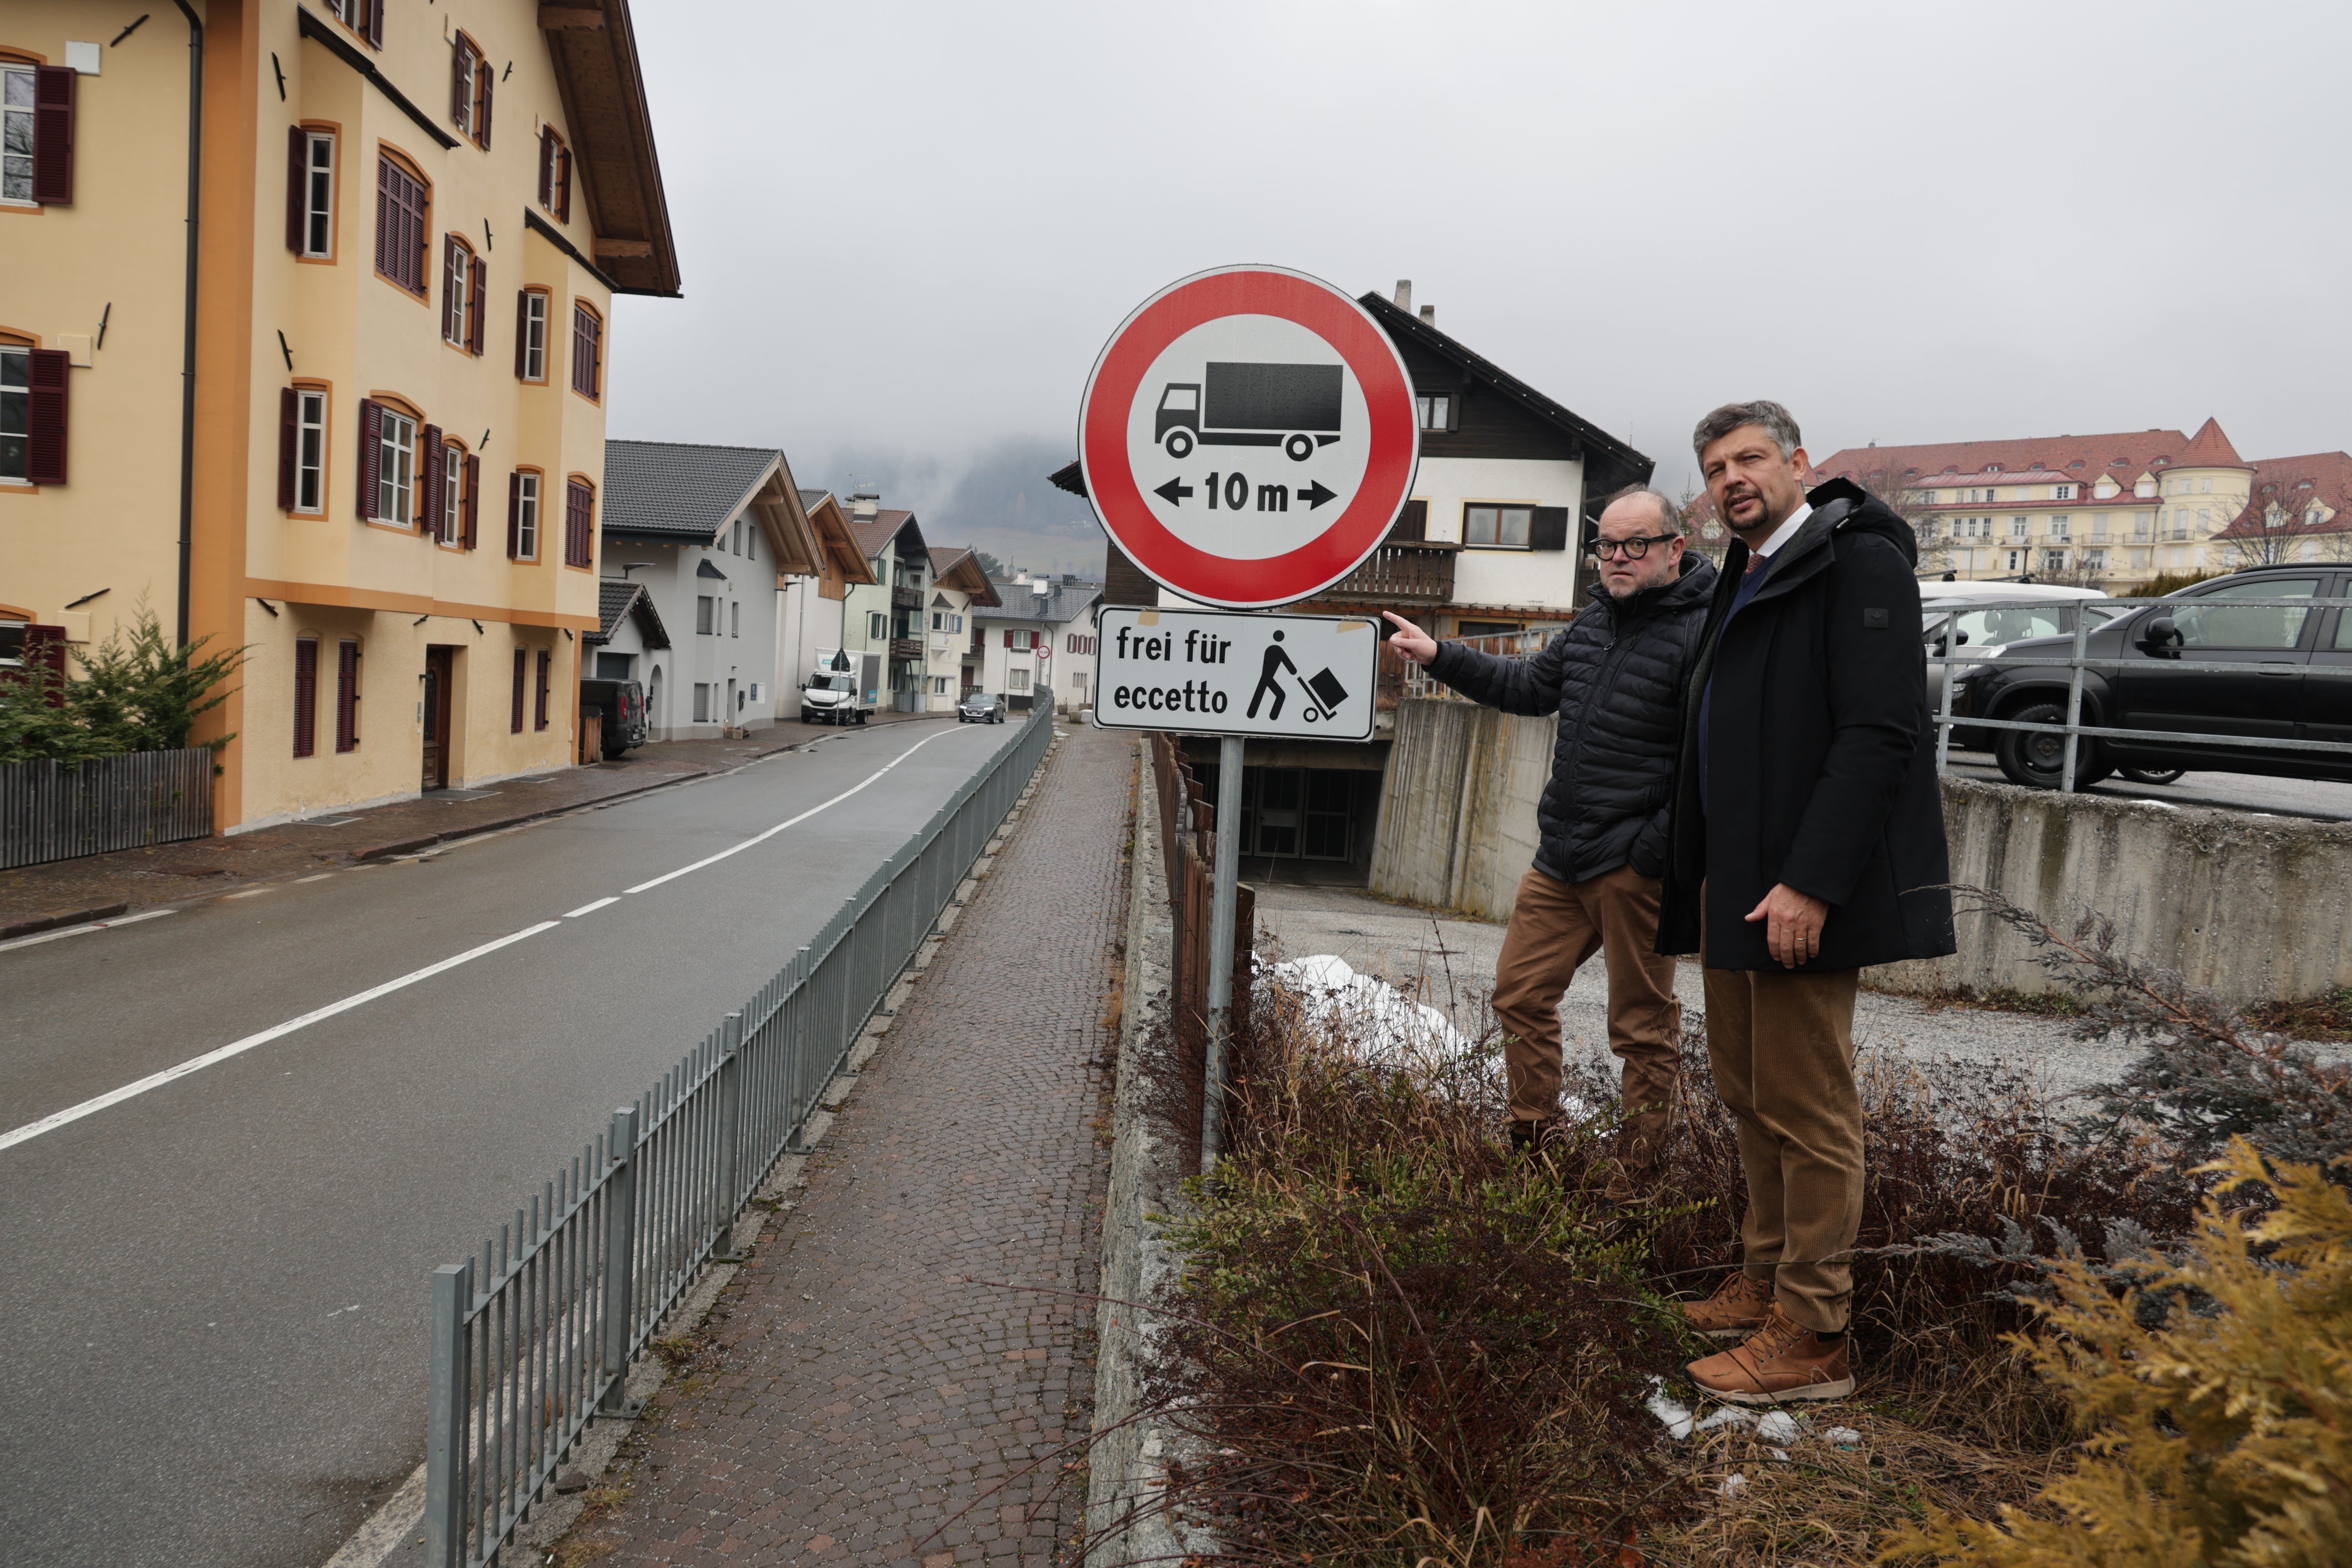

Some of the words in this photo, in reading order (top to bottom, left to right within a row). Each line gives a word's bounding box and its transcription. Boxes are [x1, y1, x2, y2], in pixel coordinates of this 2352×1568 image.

[1205, 471, 1249, 511] 10
[1257, 484, 1288, 512] m
[1116, 626, 1172, 661] frei
[1184, 629, 1231, 664] für
[1114, 679, 1228, 714] eccetto
